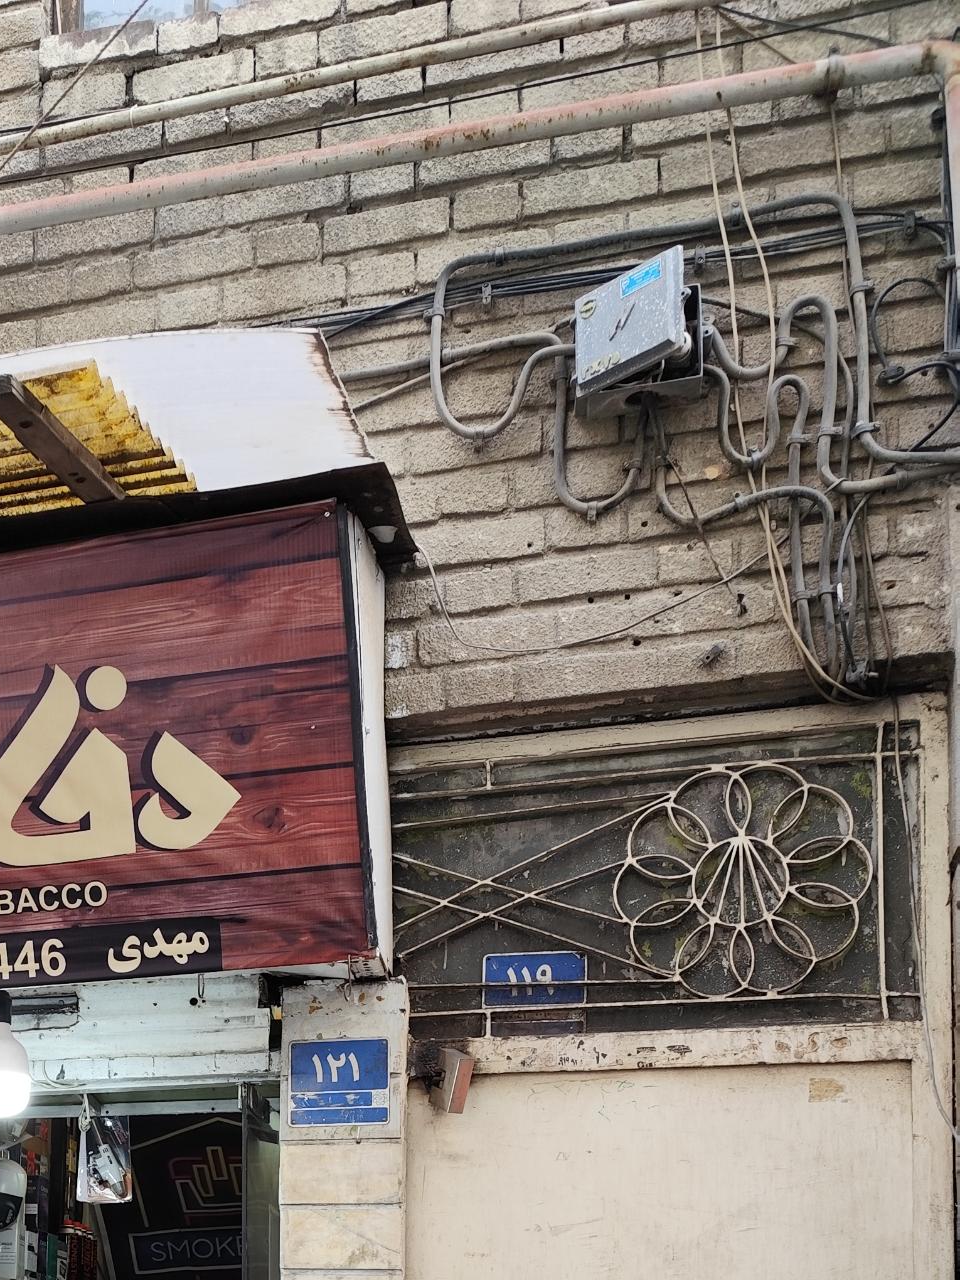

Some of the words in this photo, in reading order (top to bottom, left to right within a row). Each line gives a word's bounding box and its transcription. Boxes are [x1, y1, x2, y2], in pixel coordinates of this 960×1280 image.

[106, 926, 212, 975] مهدی
[506, 963, 554, 997] ۱۱۹
[311, 1051, 361, 1083] ۱۲۱
